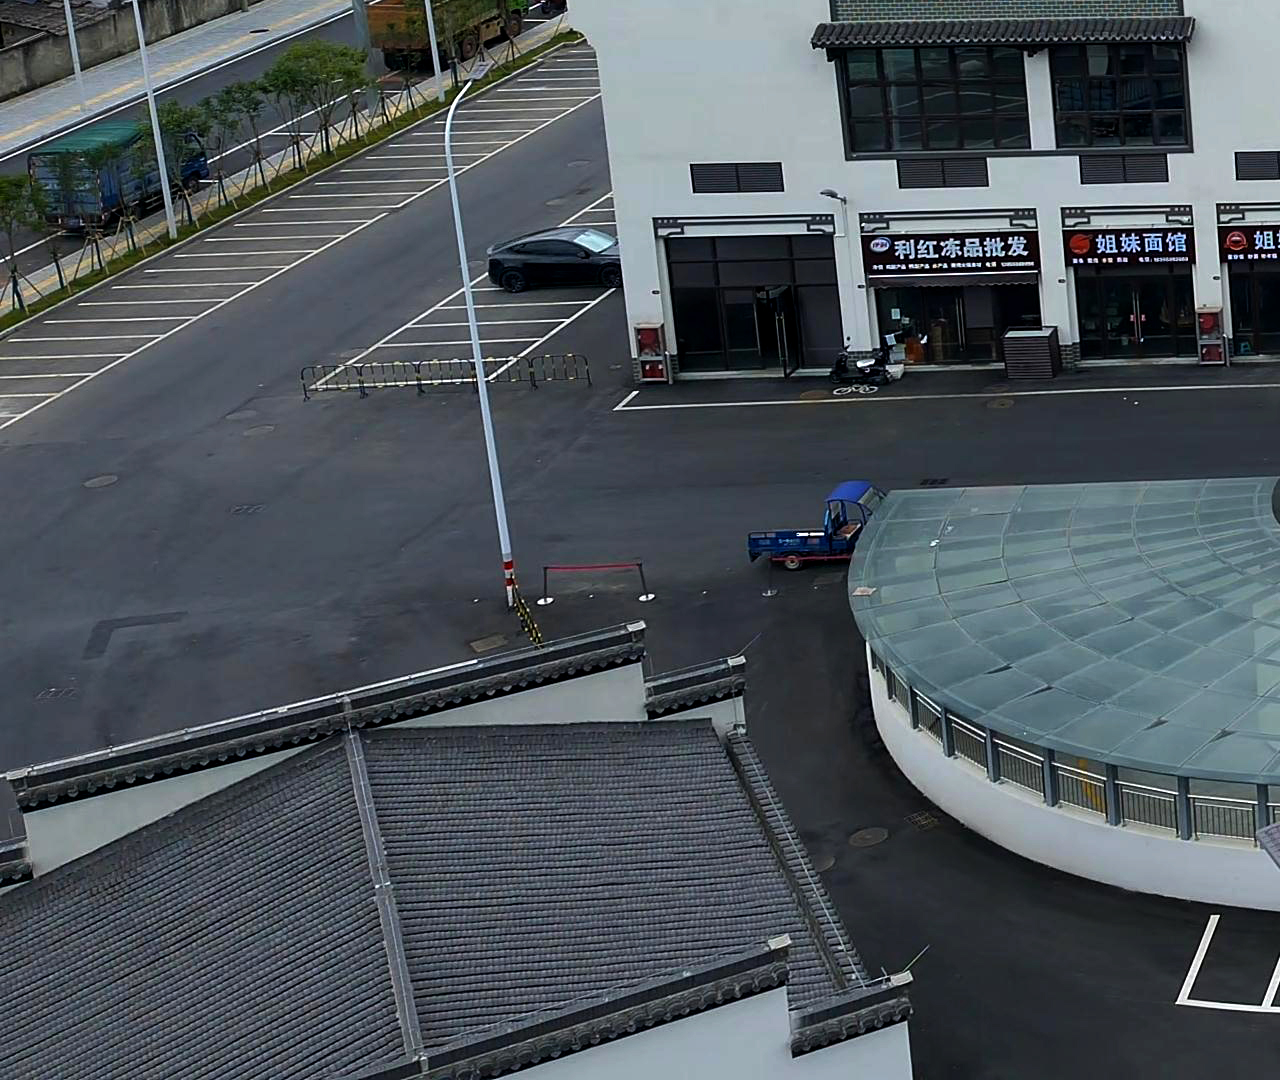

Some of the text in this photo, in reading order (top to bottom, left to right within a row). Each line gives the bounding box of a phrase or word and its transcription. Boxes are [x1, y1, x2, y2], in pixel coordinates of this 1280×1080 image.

[894, 236, 1029, 260] 利红冻品批发
[1095, 232, 1187, 254] 姐妹面馆
